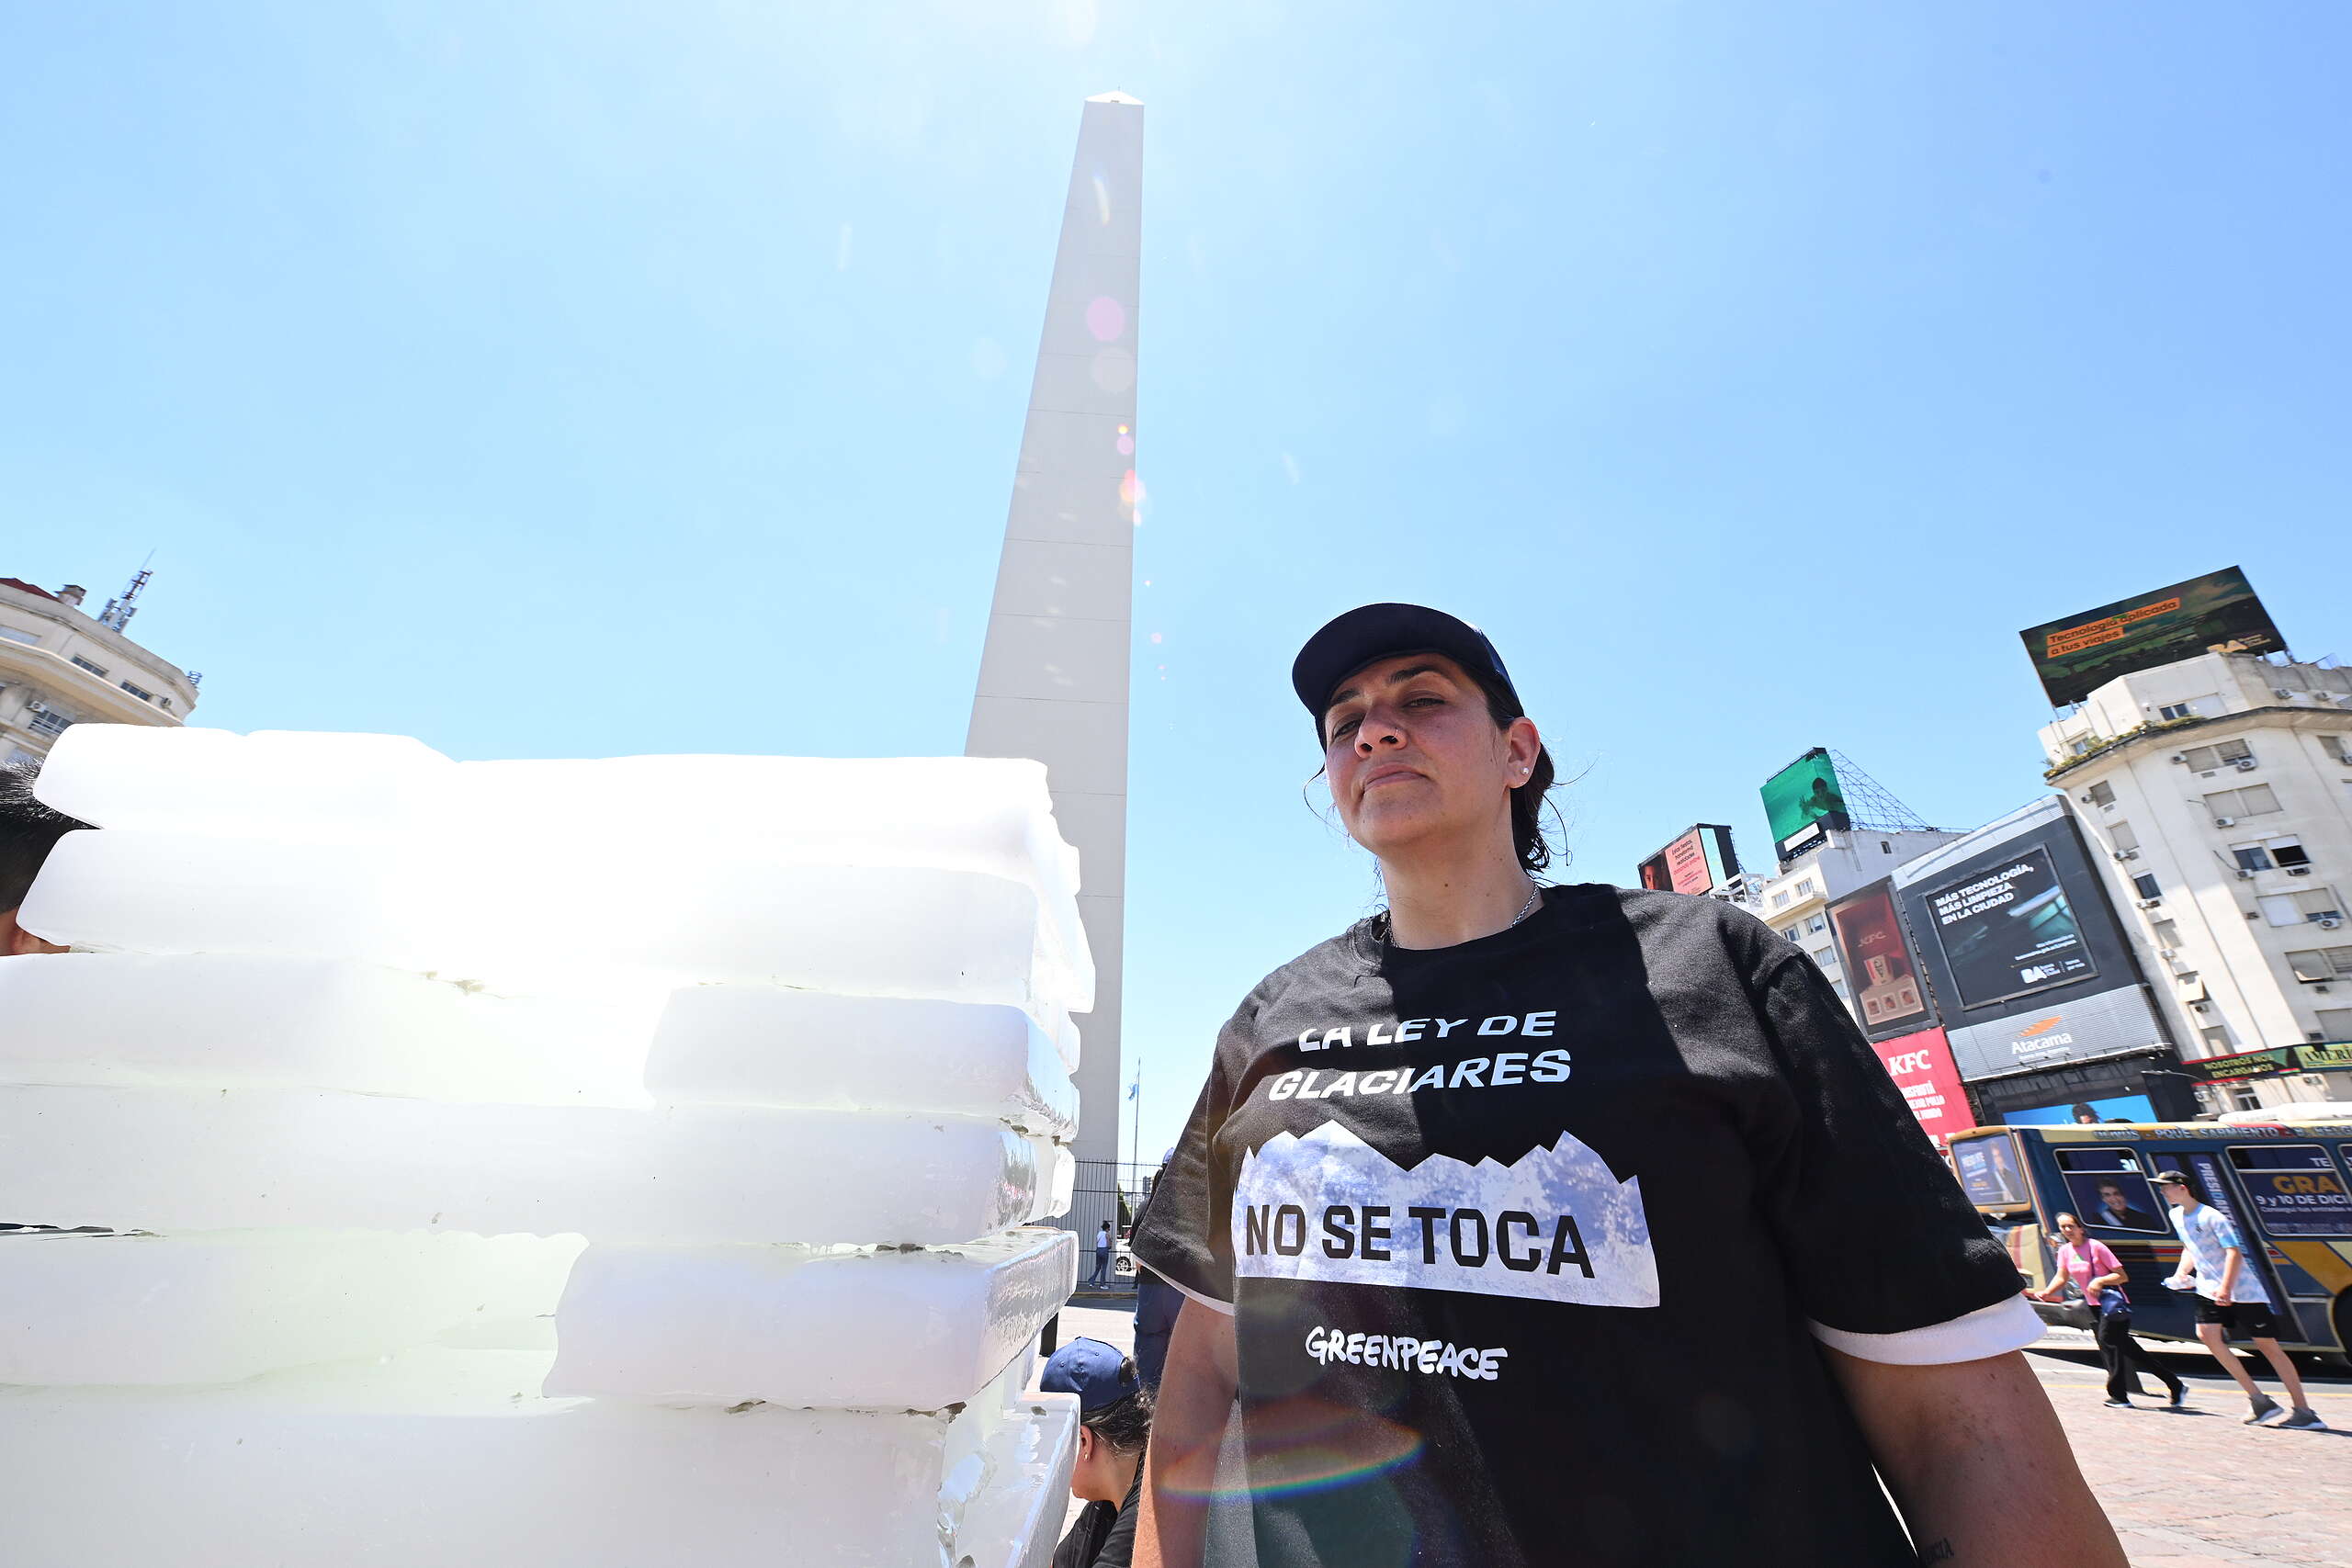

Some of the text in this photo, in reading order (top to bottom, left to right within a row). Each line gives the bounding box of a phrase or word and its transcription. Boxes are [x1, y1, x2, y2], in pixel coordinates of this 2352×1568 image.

[2120, 601, 2177, 627] aplicada
[2051, 630, 2120, 655] a tus viajes
[1935, 863, 2034, 907] MÁS TECNOLOGÍA,
[1938, 882, 2014, 916] MÁS LIMPIEZA
[1941, 892, 2014, 925] EN LA CIUDAD
[2020, 965, 2048, 984] BA
[1298, 1010, 1557, 1052] LA LEY DE
[2011, 1032, 2073, 1055] Atacama
[1269, 1049, 1571, 1100] GLACIARES
[1888, 1049, 1932, 1077] KFC
[2199, 1126, 2279, 1139] SARMIENTO
[2272, 1176, 2346, 1193] GRA
[2255, 1195, 2267, 1205] 9
[2267, 1197, 2277, 1206] y
[2277, 1195, 2294, 1204] 10
[2294, 1195, 2317, 1204] DE
[1246, 1204, 1595, 1279] NO SE TOCA
[1306, 1325, 1508, 1380] GREENPEACE
